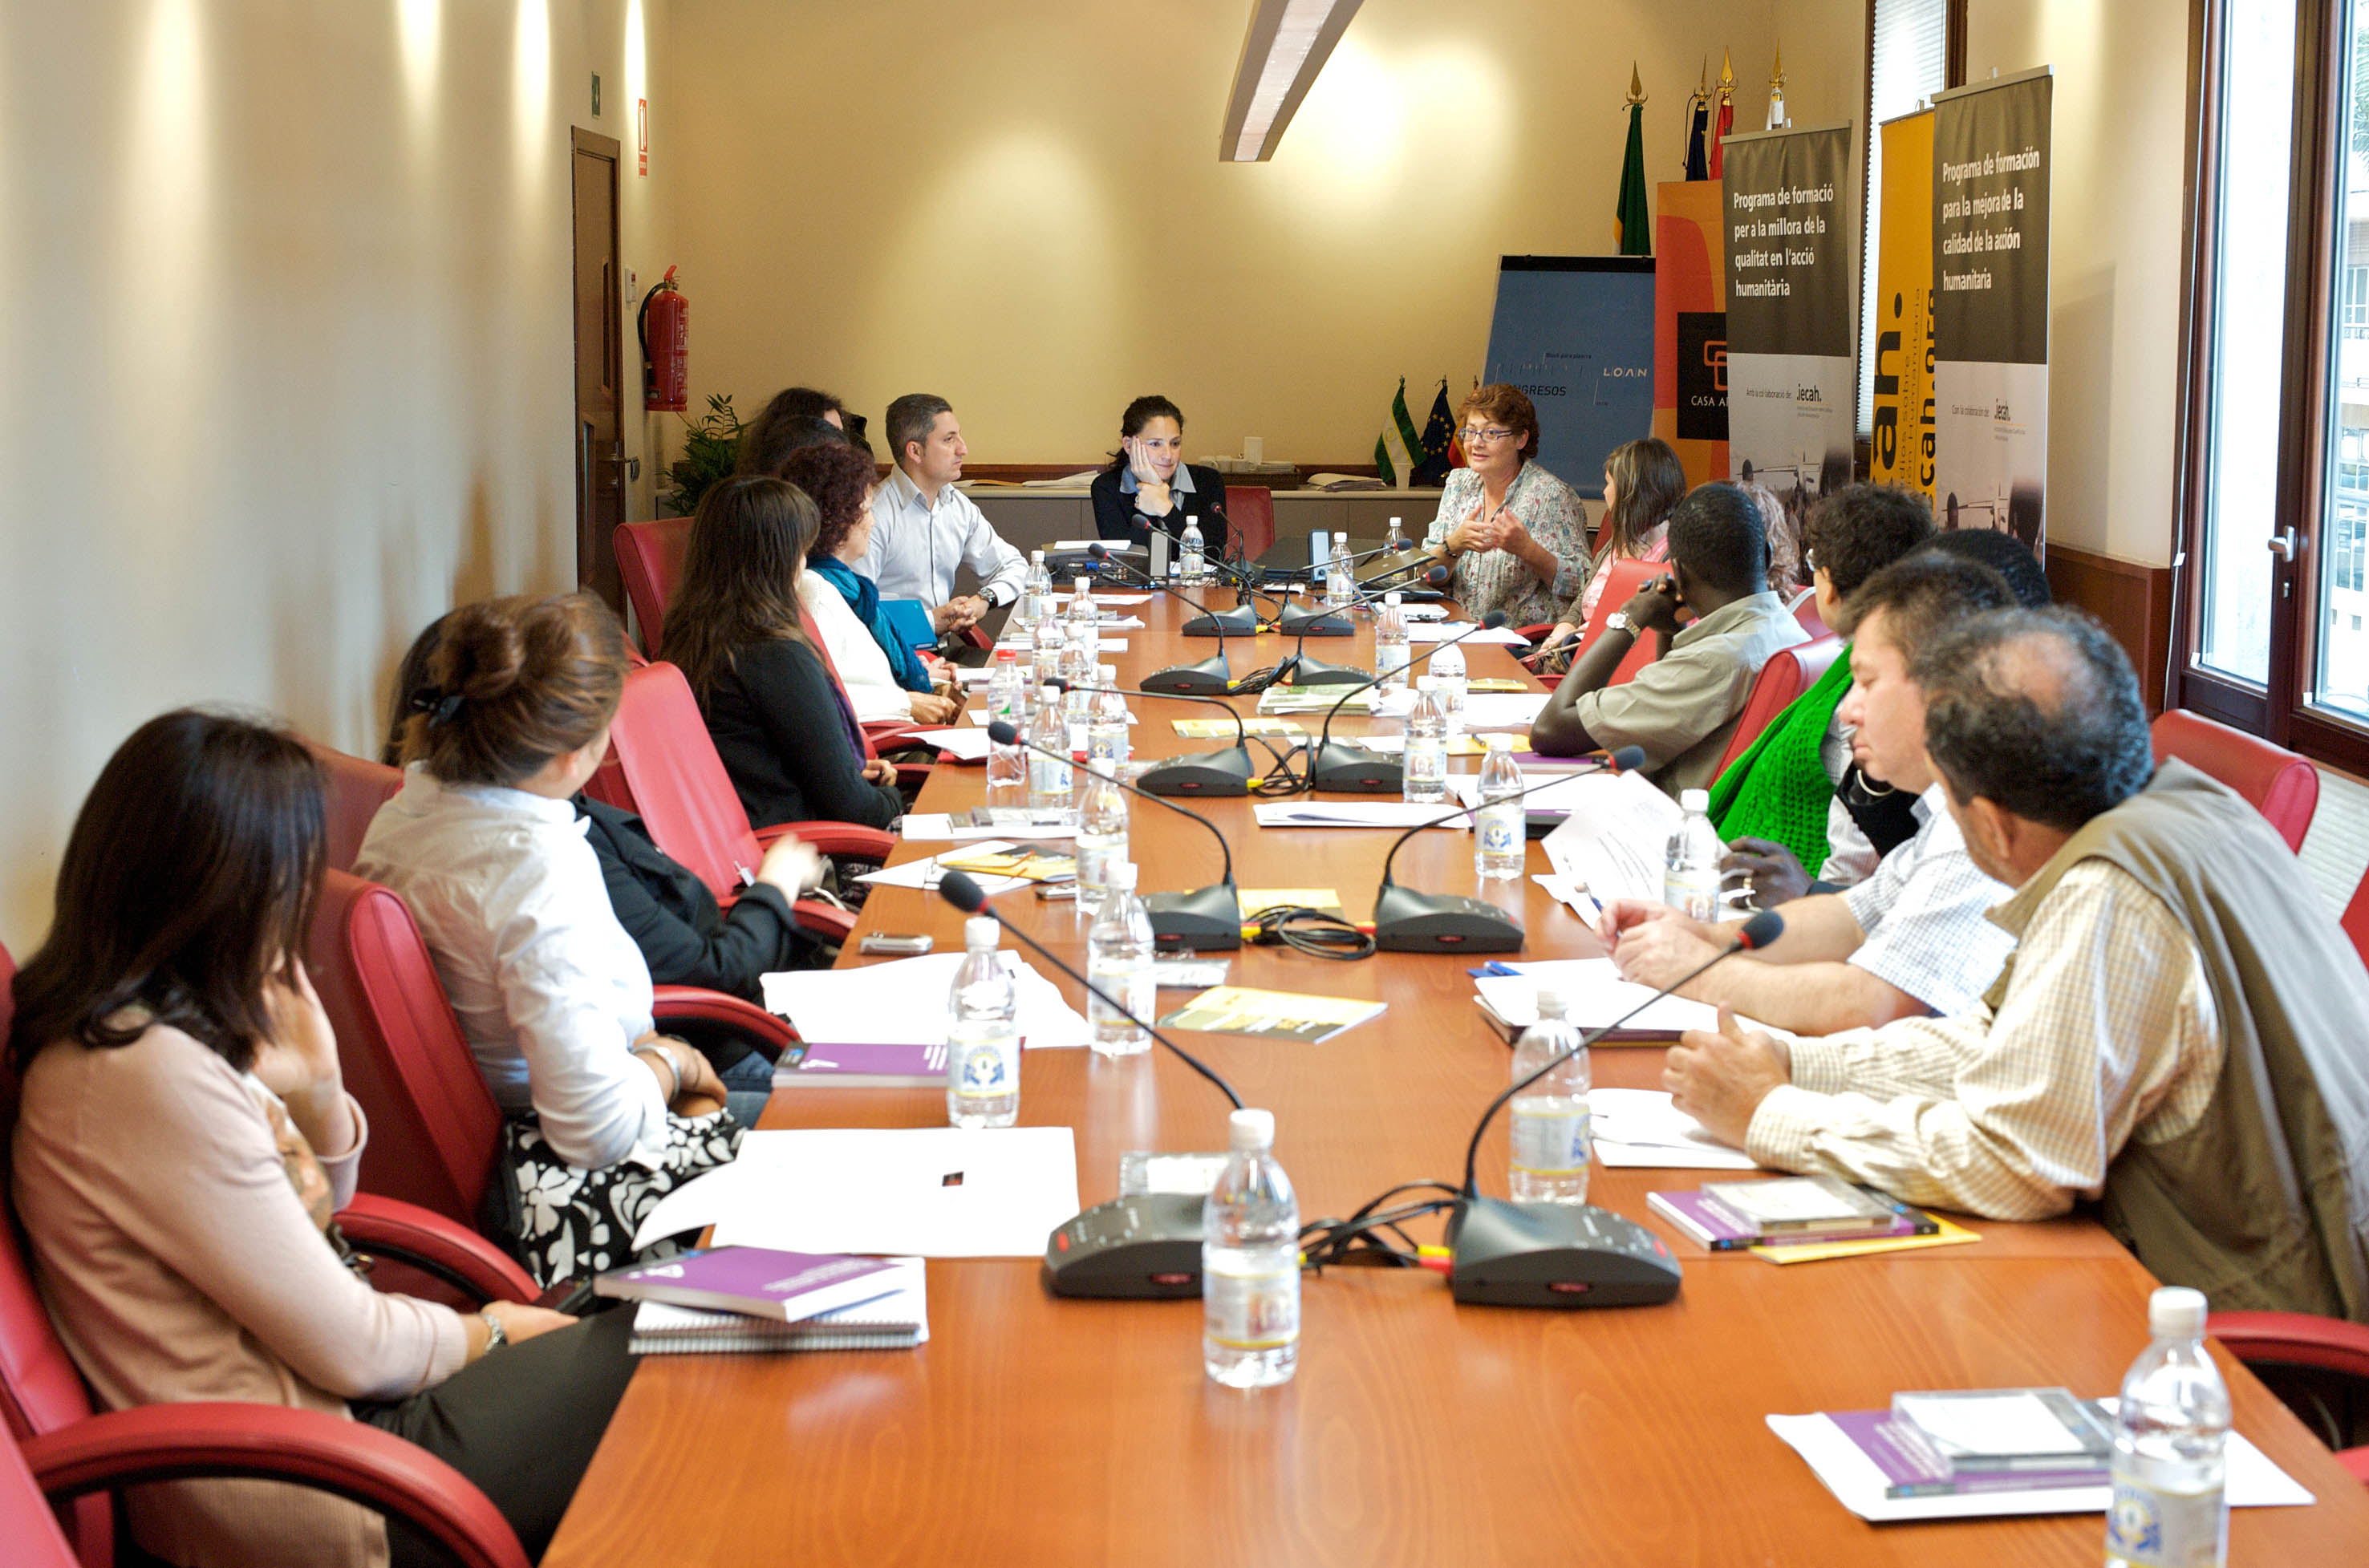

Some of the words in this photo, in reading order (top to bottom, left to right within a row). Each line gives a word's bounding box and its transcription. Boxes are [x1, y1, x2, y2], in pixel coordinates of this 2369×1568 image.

[1942, 162, 1982, 186] Programa
[1983, 152, 1994, 176] de
[1995, 146, 2040, 174] formación
[1734, 192, 1775, 212] Programa
[1778, 187, 1790, 205] de
[1792, 184, 1834, 204] formació
[1943, 200, 1961, 225] para
[1962, 195, 1971, 217] la
[1973, 192, 2000, 220] mejora
[2001, 188, 2011, 212] de
[2014, 187, 2024, 210] la
[1734, 225, 1750, 242] per
[1750, 225, 1757, 237] a
[1758, 219, 1767, 237] la
[1768, 217, 1802, 236] millora
[1804, 216, 1815, 233] de
[1816, 215, 1826, 233] la
[1943, 231, 1973, 255] calidad
[1973, 230, 1984, 252] de
[1985, 229, 1994, 251] la
[1994, 226, 2021, 250] acción
[1735, 249, 1769, 272] qualitat
[1771, 253, 1783, 266] en
[1785, 247, 1815, 265] l'acció
[1735, 278, 1791, 297] humanitària
[1943, 267, 1992, 292] humanitaria
[1691, 395, 1715, 407] CASA
[1872, 292, 1902, 483] ah.
